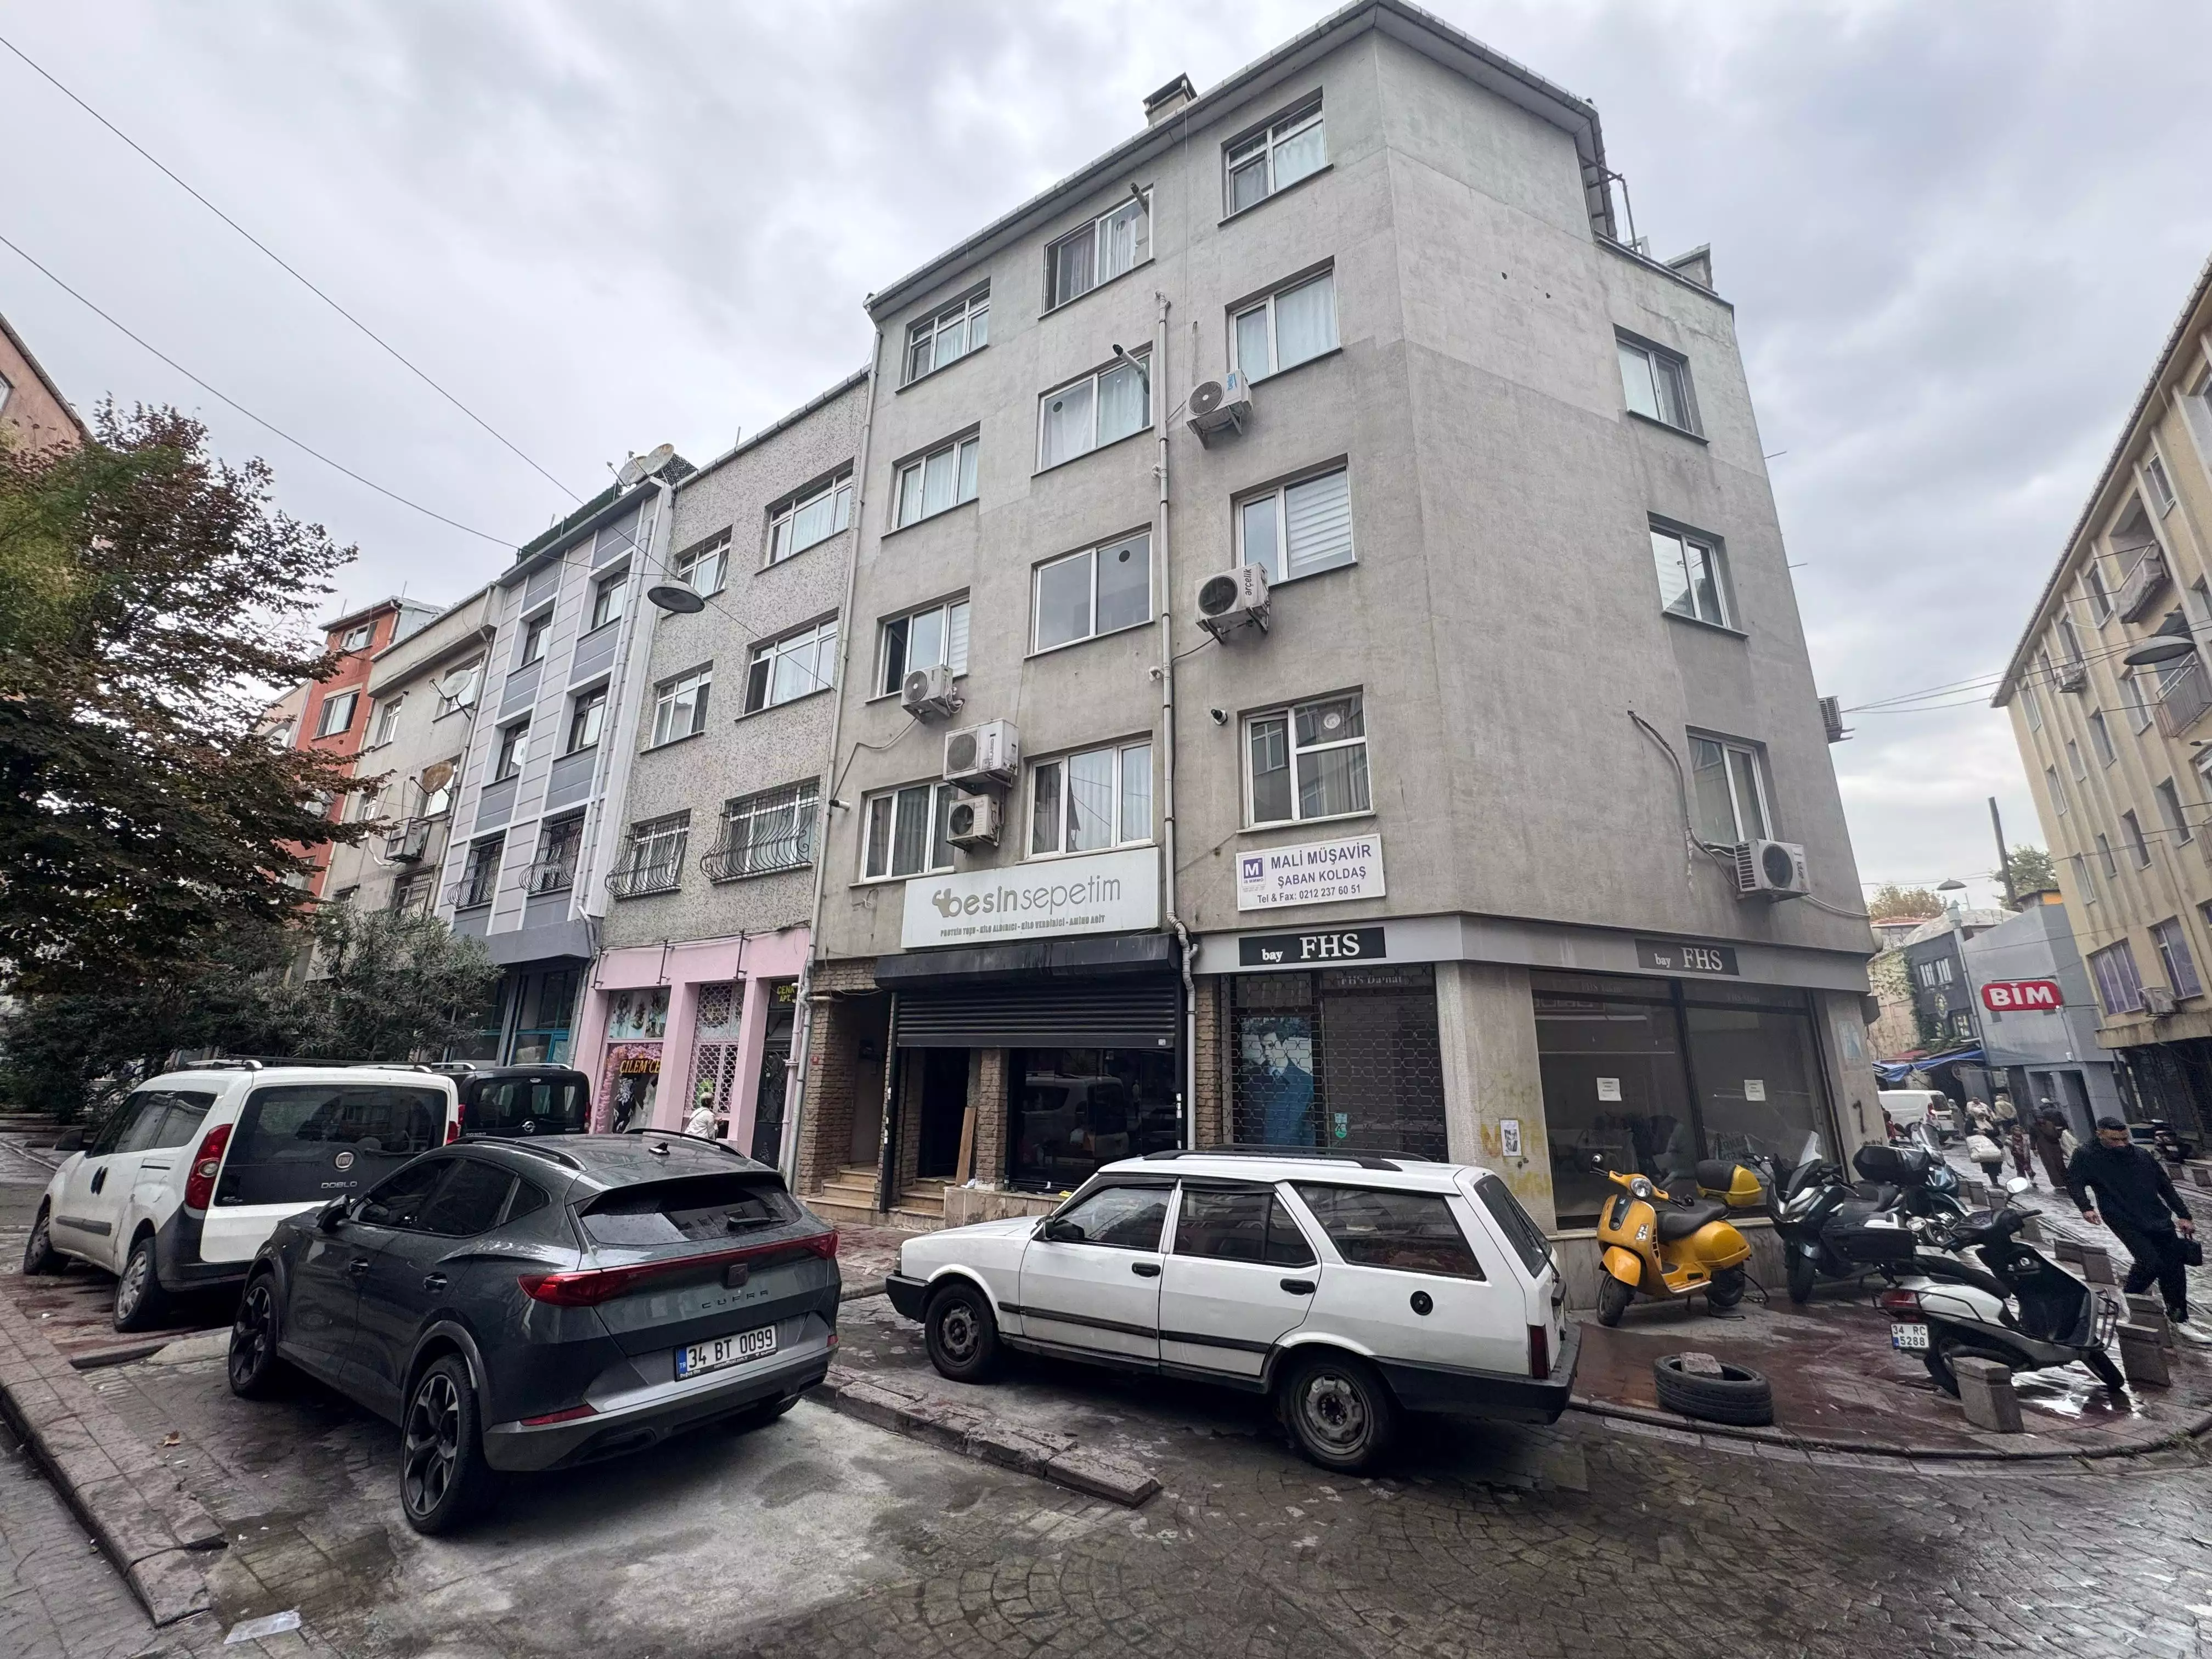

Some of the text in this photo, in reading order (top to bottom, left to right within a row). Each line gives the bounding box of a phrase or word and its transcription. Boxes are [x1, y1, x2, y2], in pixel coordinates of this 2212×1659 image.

[1243, 568, 1254, 596] arçelik
[1271, 842, 1372, 870] MALİ MÜŞAVİR
[1278, 872, 1316, 889] ŞABAN
[1319, 866, 1367, 882] KOLDAŞ
[1257, 884, 1361, 904] Tel & Fax: 0212 237 60 51
[1262, 933, 1360, 962] bay FHS
[1655, 947, 1723, 971] bay FHS
[702, 1290, 768, 1309] CUPRA
[1893, 1325, 1926, 1335] 34 RC
[1900, 1336, 1925, 1346] 5288
[688, 1329, 773, 1369] 34 BT 0099
